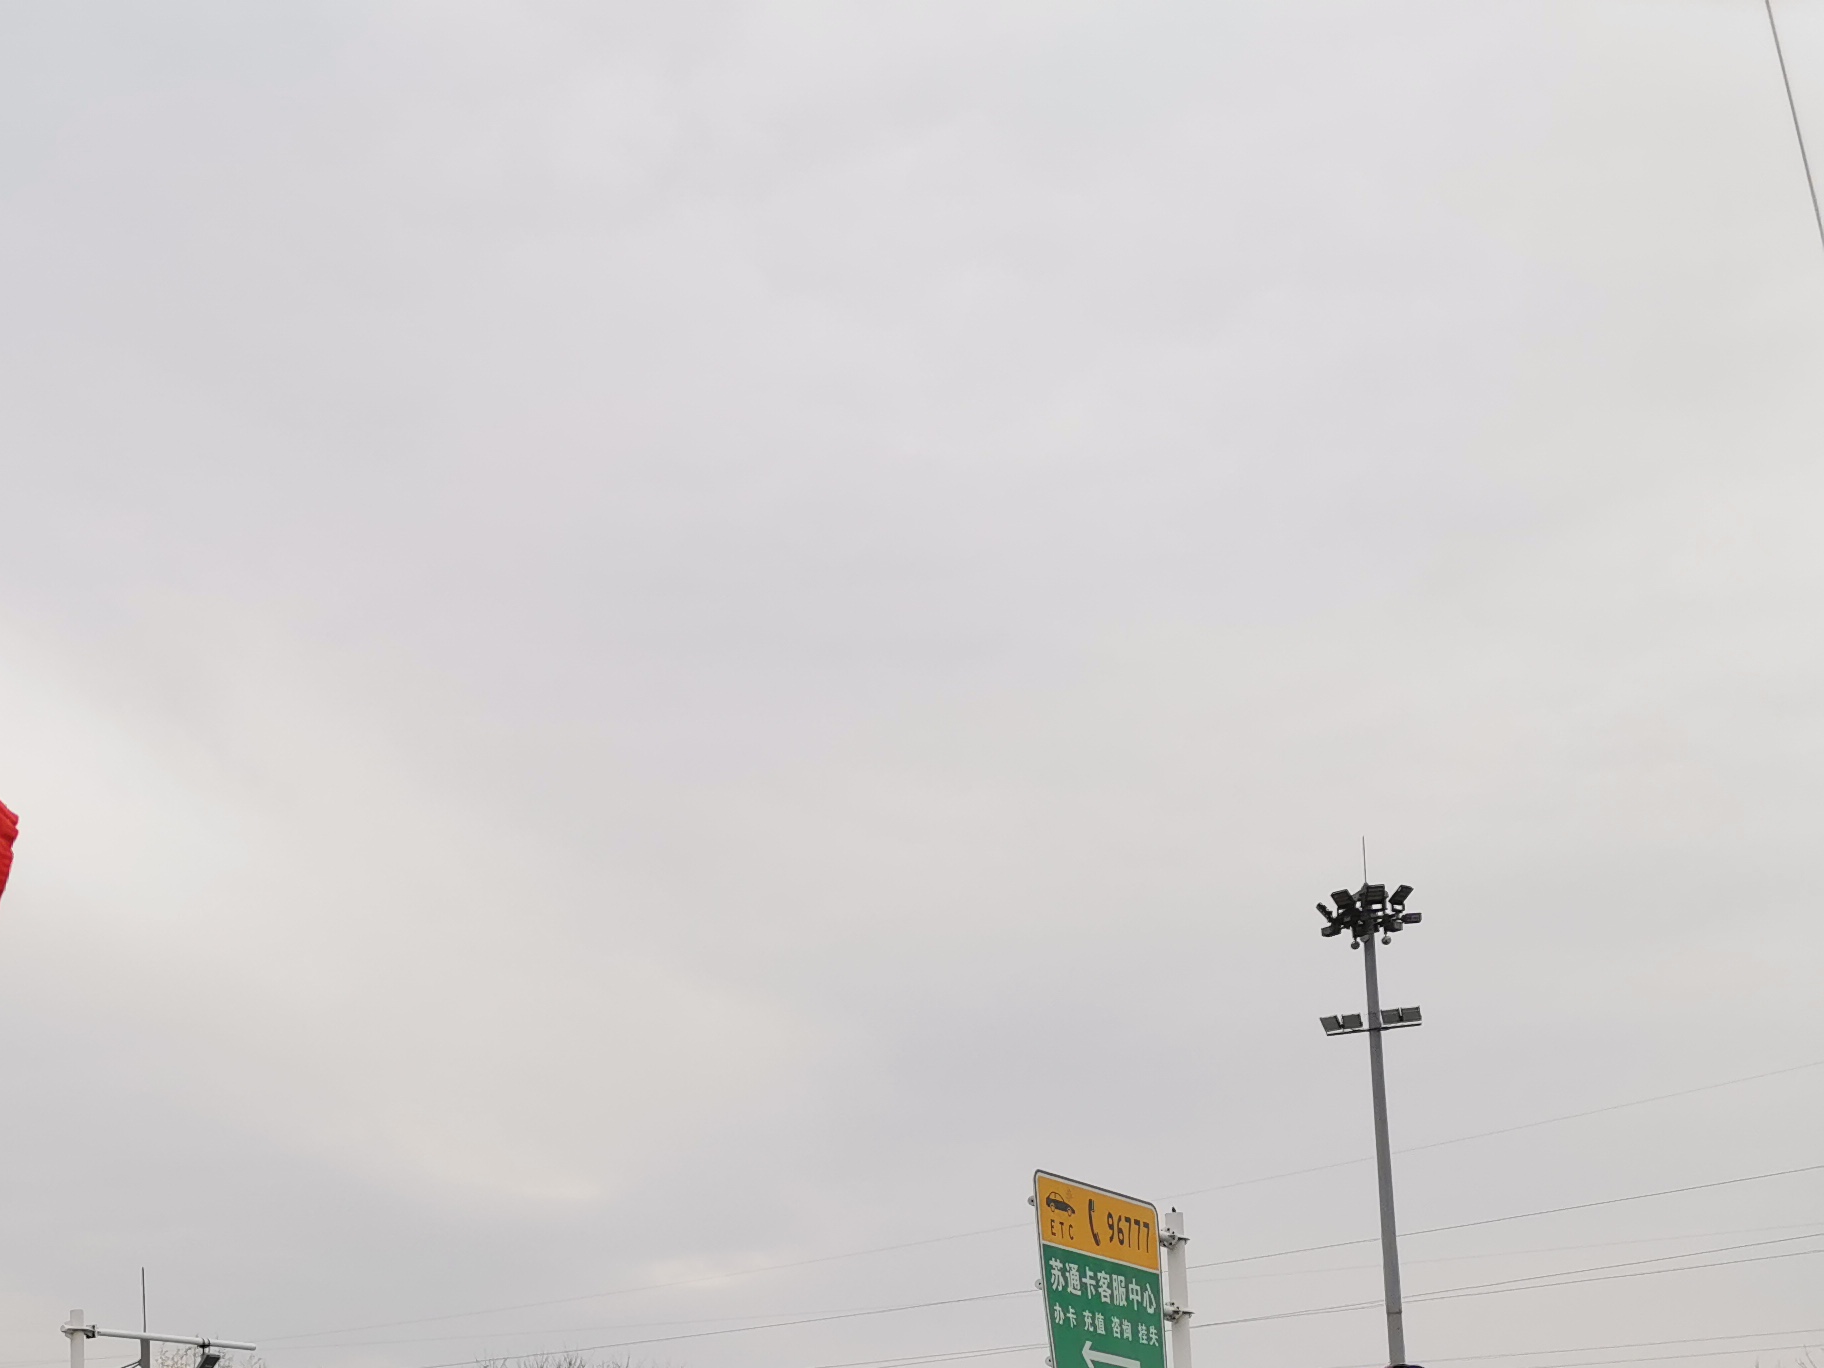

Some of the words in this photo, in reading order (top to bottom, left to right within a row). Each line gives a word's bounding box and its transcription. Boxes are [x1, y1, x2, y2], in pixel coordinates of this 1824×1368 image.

[1050, 1218, 1075, 1241] ETC
[1107, 1211, 1150, 1254] 96777
[1049, 1257, 1157, 1314] 苏通卡客服中心
[1054, 1302, 1077, 1328] 办卡
[1083, 1310, 1106, 1336] 充值
[1111, 1316, 1133, 1341] 咨询
[1138, 1322, 1159, 1347] 挂失
